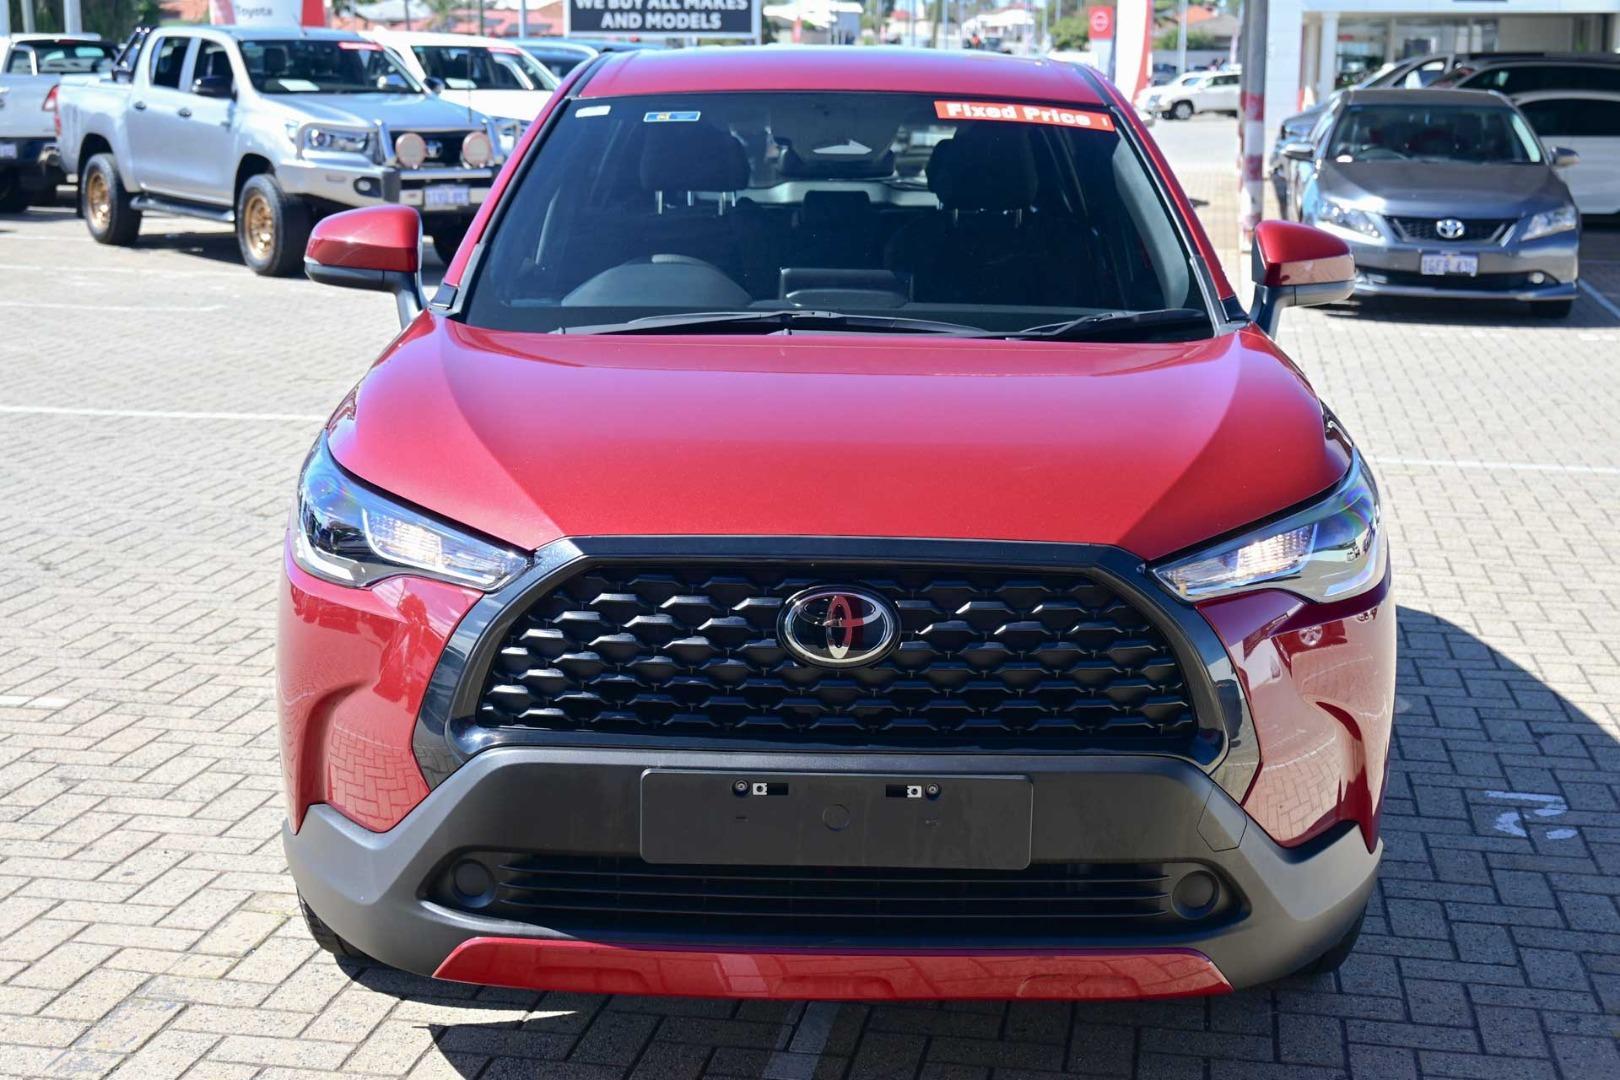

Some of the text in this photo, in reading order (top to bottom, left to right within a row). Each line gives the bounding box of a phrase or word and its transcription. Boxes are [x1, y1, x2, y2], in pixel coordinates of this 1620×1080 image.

[576, 0, 748, 9] WE BUY ALL MAKES
[600, 12, 722, 29] AND MODELS
[946, 103, 1091, 126] Fixed Price
